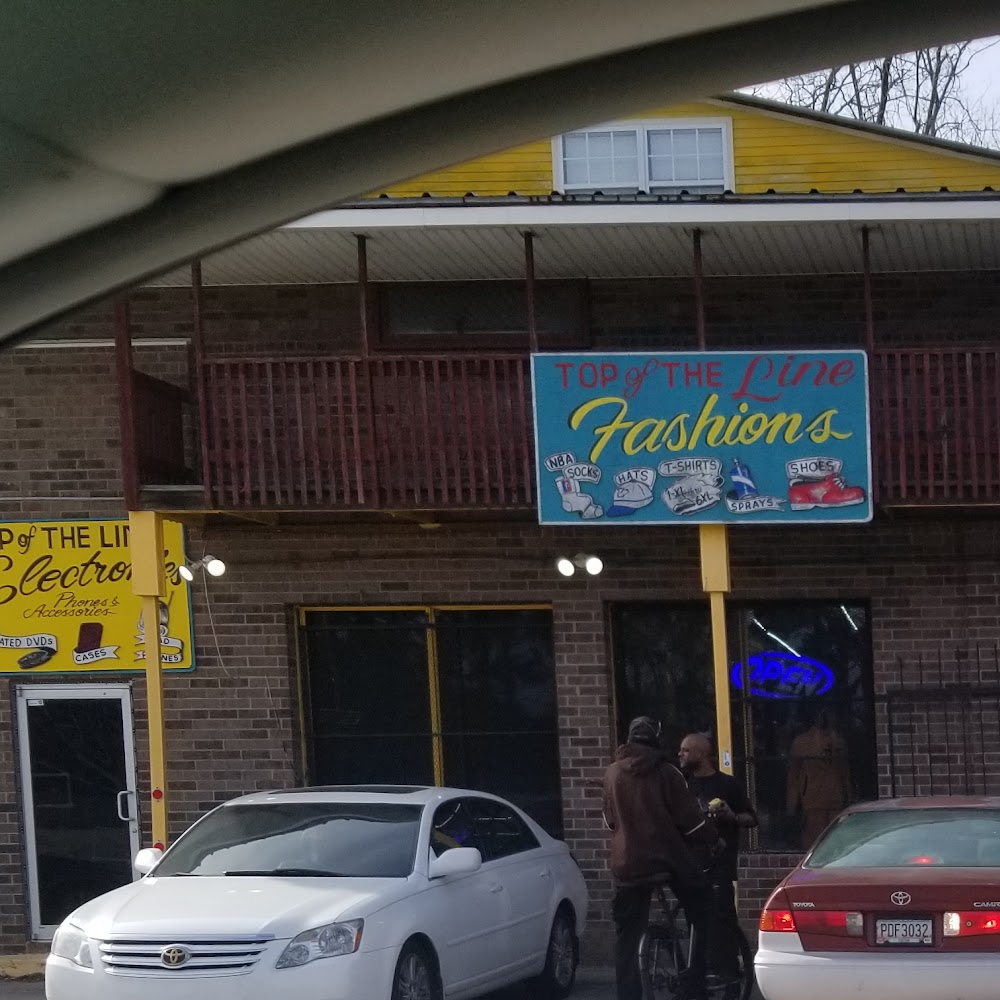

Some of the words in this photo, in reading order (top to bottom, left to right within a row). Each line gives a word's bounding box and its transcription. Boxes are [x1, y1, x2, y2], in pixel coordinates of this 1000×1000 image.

[555, 362, 618, 388] TOP
[622, 358, 658, 399] of
[660, 361, 723, 387] THE
[731, 355, 855, 402] Line
[570, 393, 853, 463] Fashions
[549, 454, 574, 469] NBA
[664, 460, 717, 473] T-SHIRTS
[790, 460, 835, 474] SHOES
[567, 466, 598, 479] SOCKS
[619, 470, 649, 484] HATS
[731, 498, 774, 511] SPRAYS
[17, 525, 37, 554] of
[41, 526, 91, 549] THE
[54, 591, 107, 608] Phones
[23, 604, 117, 618] Accessories
[26, 636, 53, 647] DVDs
[75, 649, 107, 663] CASES
[880, 923, 929, 938] PDF3032
